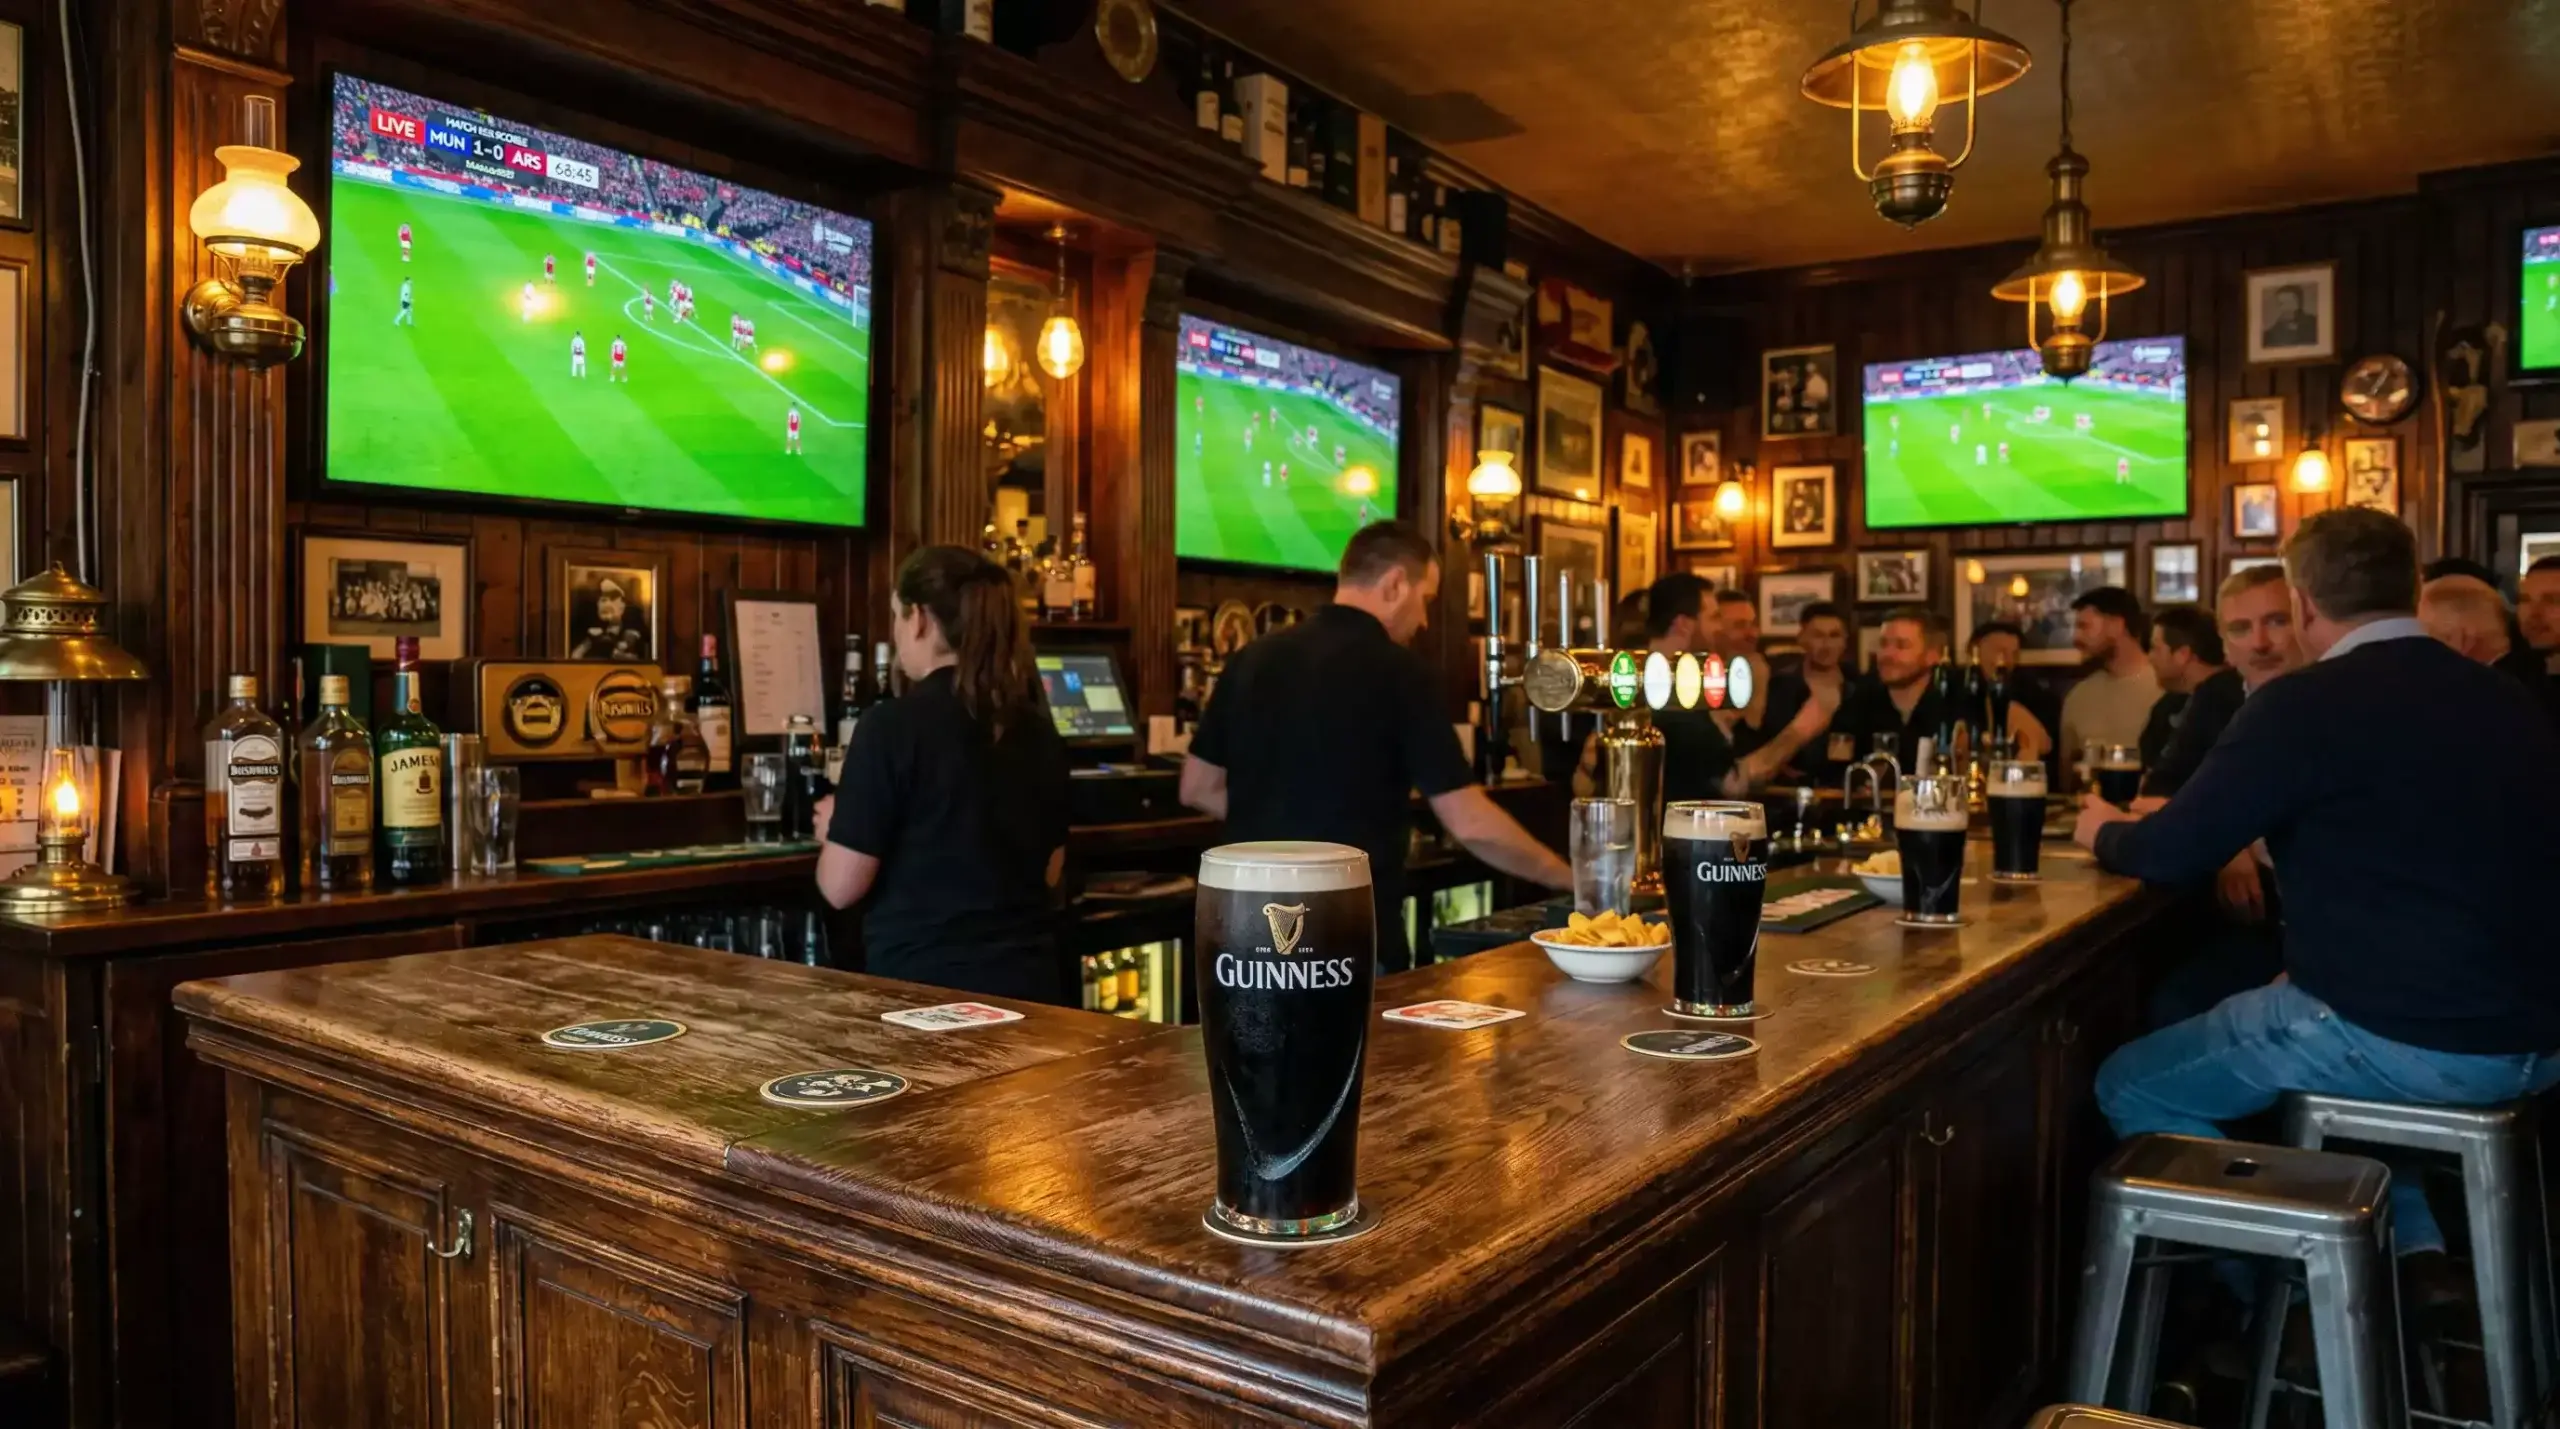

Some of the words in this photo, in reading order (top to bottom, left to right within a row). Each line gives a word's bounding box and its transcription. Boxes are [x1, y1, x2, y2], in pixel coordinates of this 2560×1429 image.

[377, 113, 416, 138] LIVE
[430, 128, 466, 151] MUN
[473, 139, 504, 160] 1-0
[511, 149, 542, 171] ARS
[1215, 952, 1353, 990] GUINNESS
